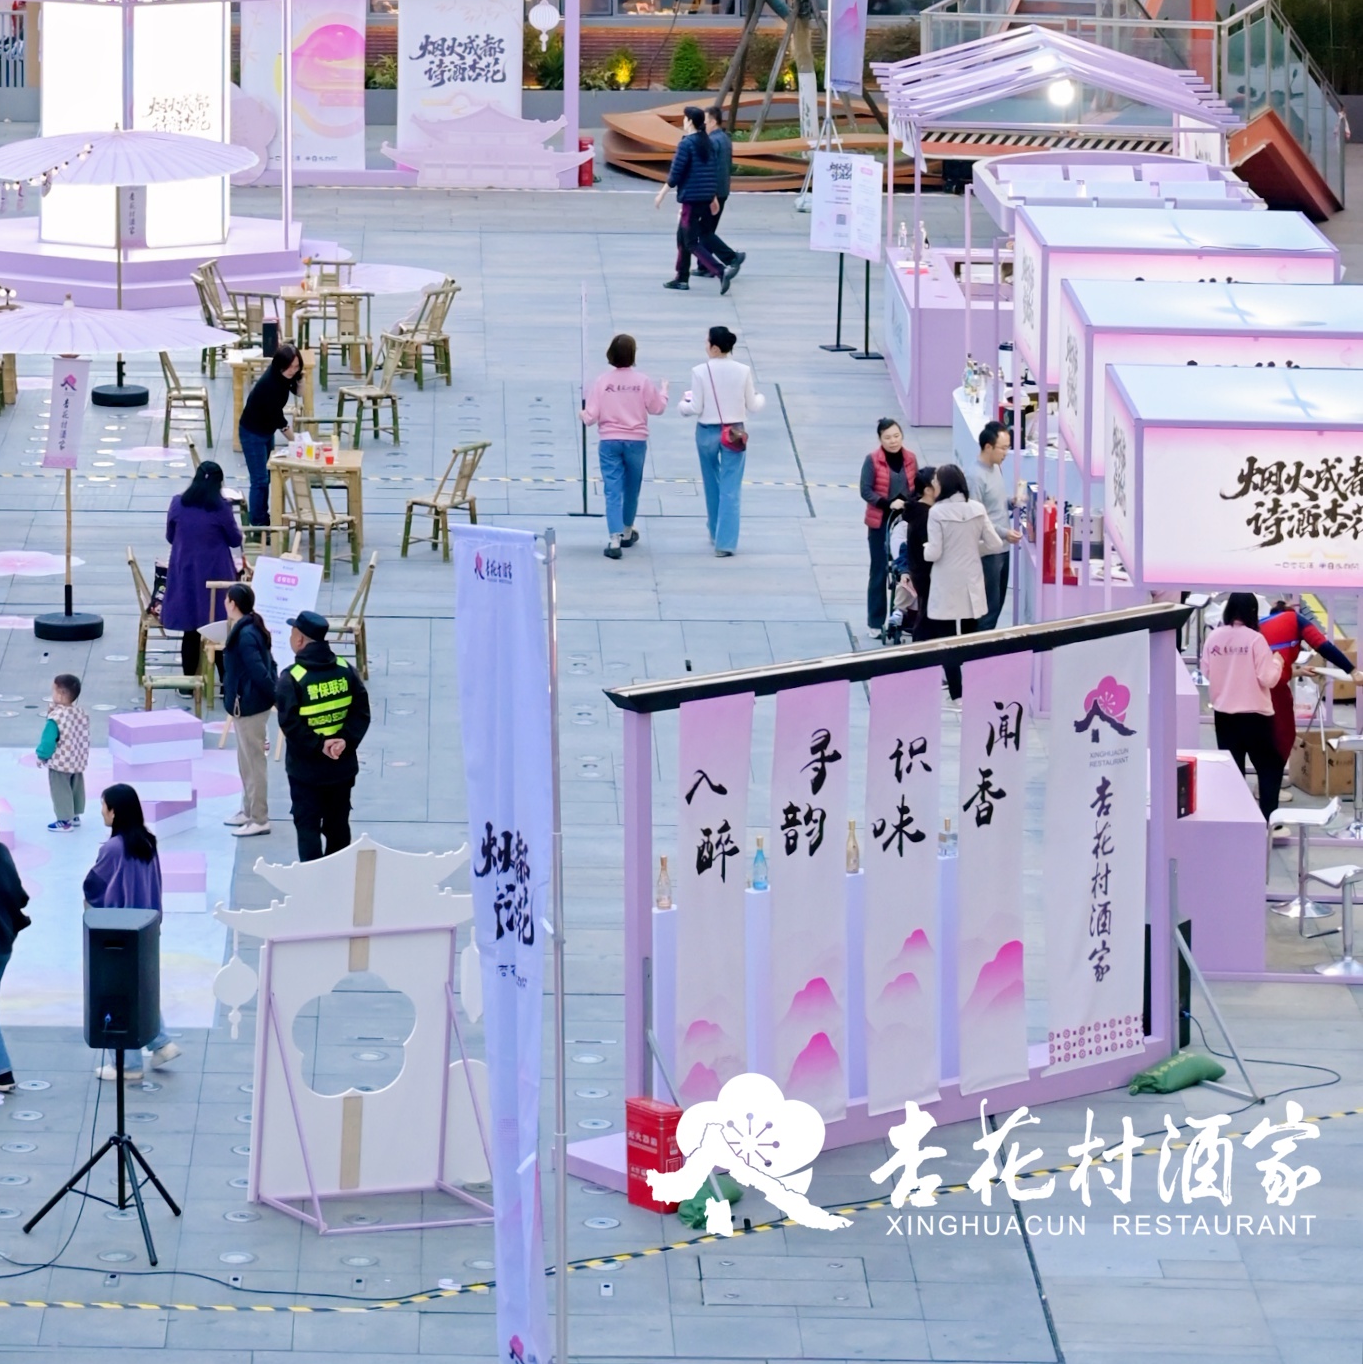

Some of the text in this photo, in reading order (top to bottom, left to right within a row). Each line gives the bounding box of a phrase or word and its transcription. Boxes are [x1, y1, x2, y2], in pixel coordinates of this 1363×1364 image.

[408, 34, 505, 61] 烟火成都
[424, 57, 507, 89] 诗酒杏花
[1237, 497, 1363, 550] 诗酒杏
[780, 728, 842, 857] 寻韵
[963, 701, 1023, 827] 闻香
[1089, 748, 1130, 759] XINGHUACUN
[1089, 756, 1129, 768] RESTAURANT
[685, 769, 740, 883] 入醉
[871, 736, 932, 858] 识味
[1088, 776, 1115, 982] 杏花村酒家
